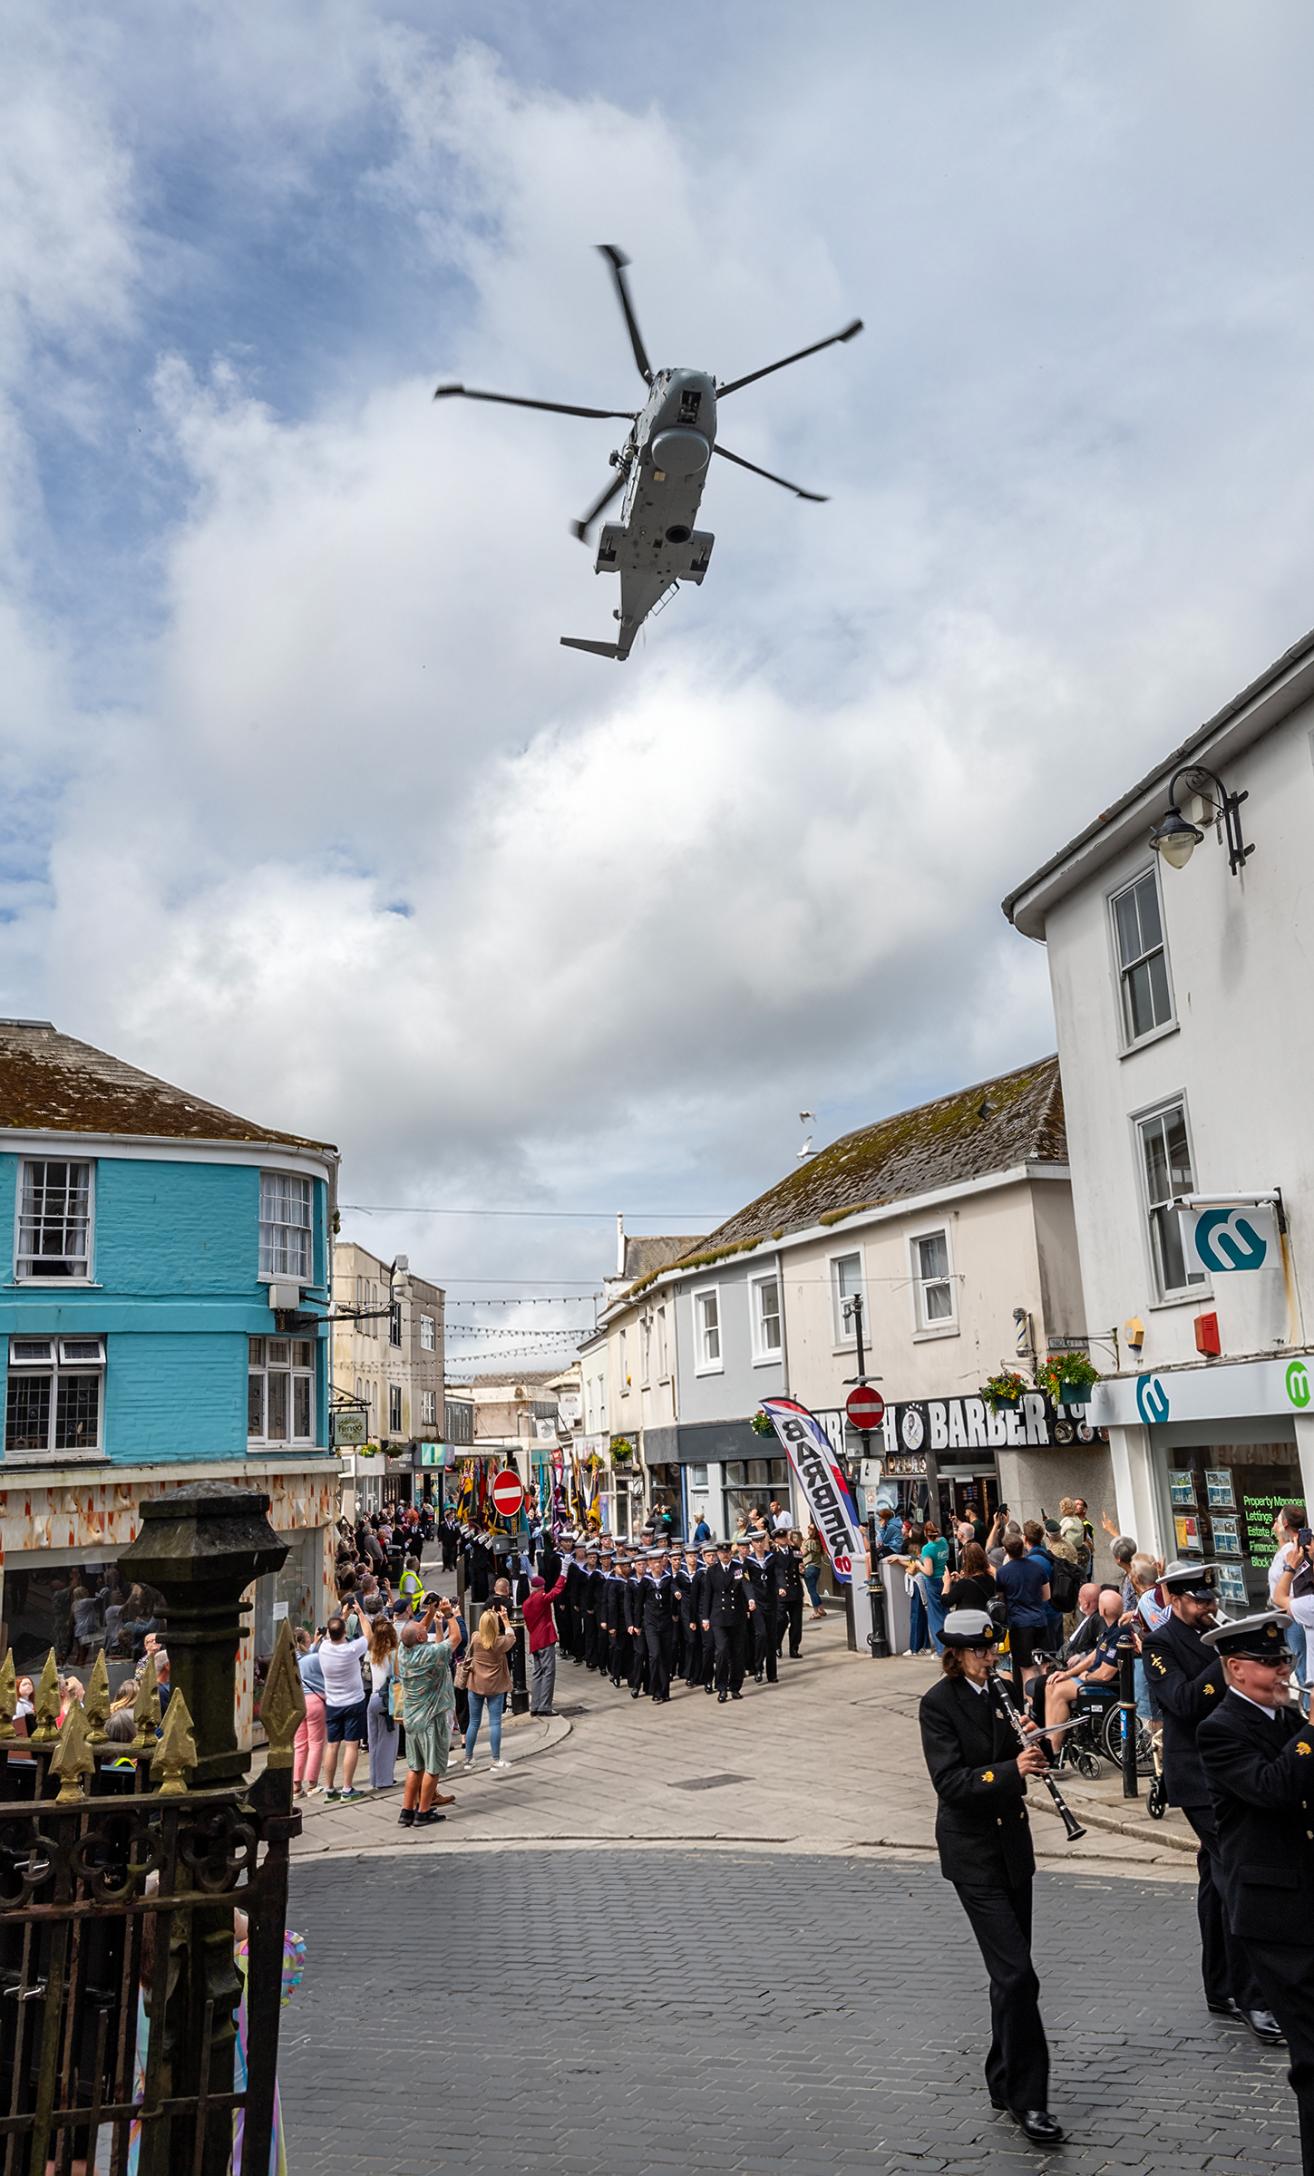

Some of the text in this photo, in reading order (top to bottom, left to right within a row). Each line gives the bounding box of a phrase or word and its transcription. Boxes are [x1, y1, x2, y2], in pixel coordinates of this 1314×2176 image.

[928, 1393, 1050, 1449] BARBER
[1243, 1496, 1273, 1509] Property
[1245, 1510, 1273, 1524] Lettings
[1247, 1526, 1270, 1537] Estate
[1251, 1556, 1269, 1567] Block
